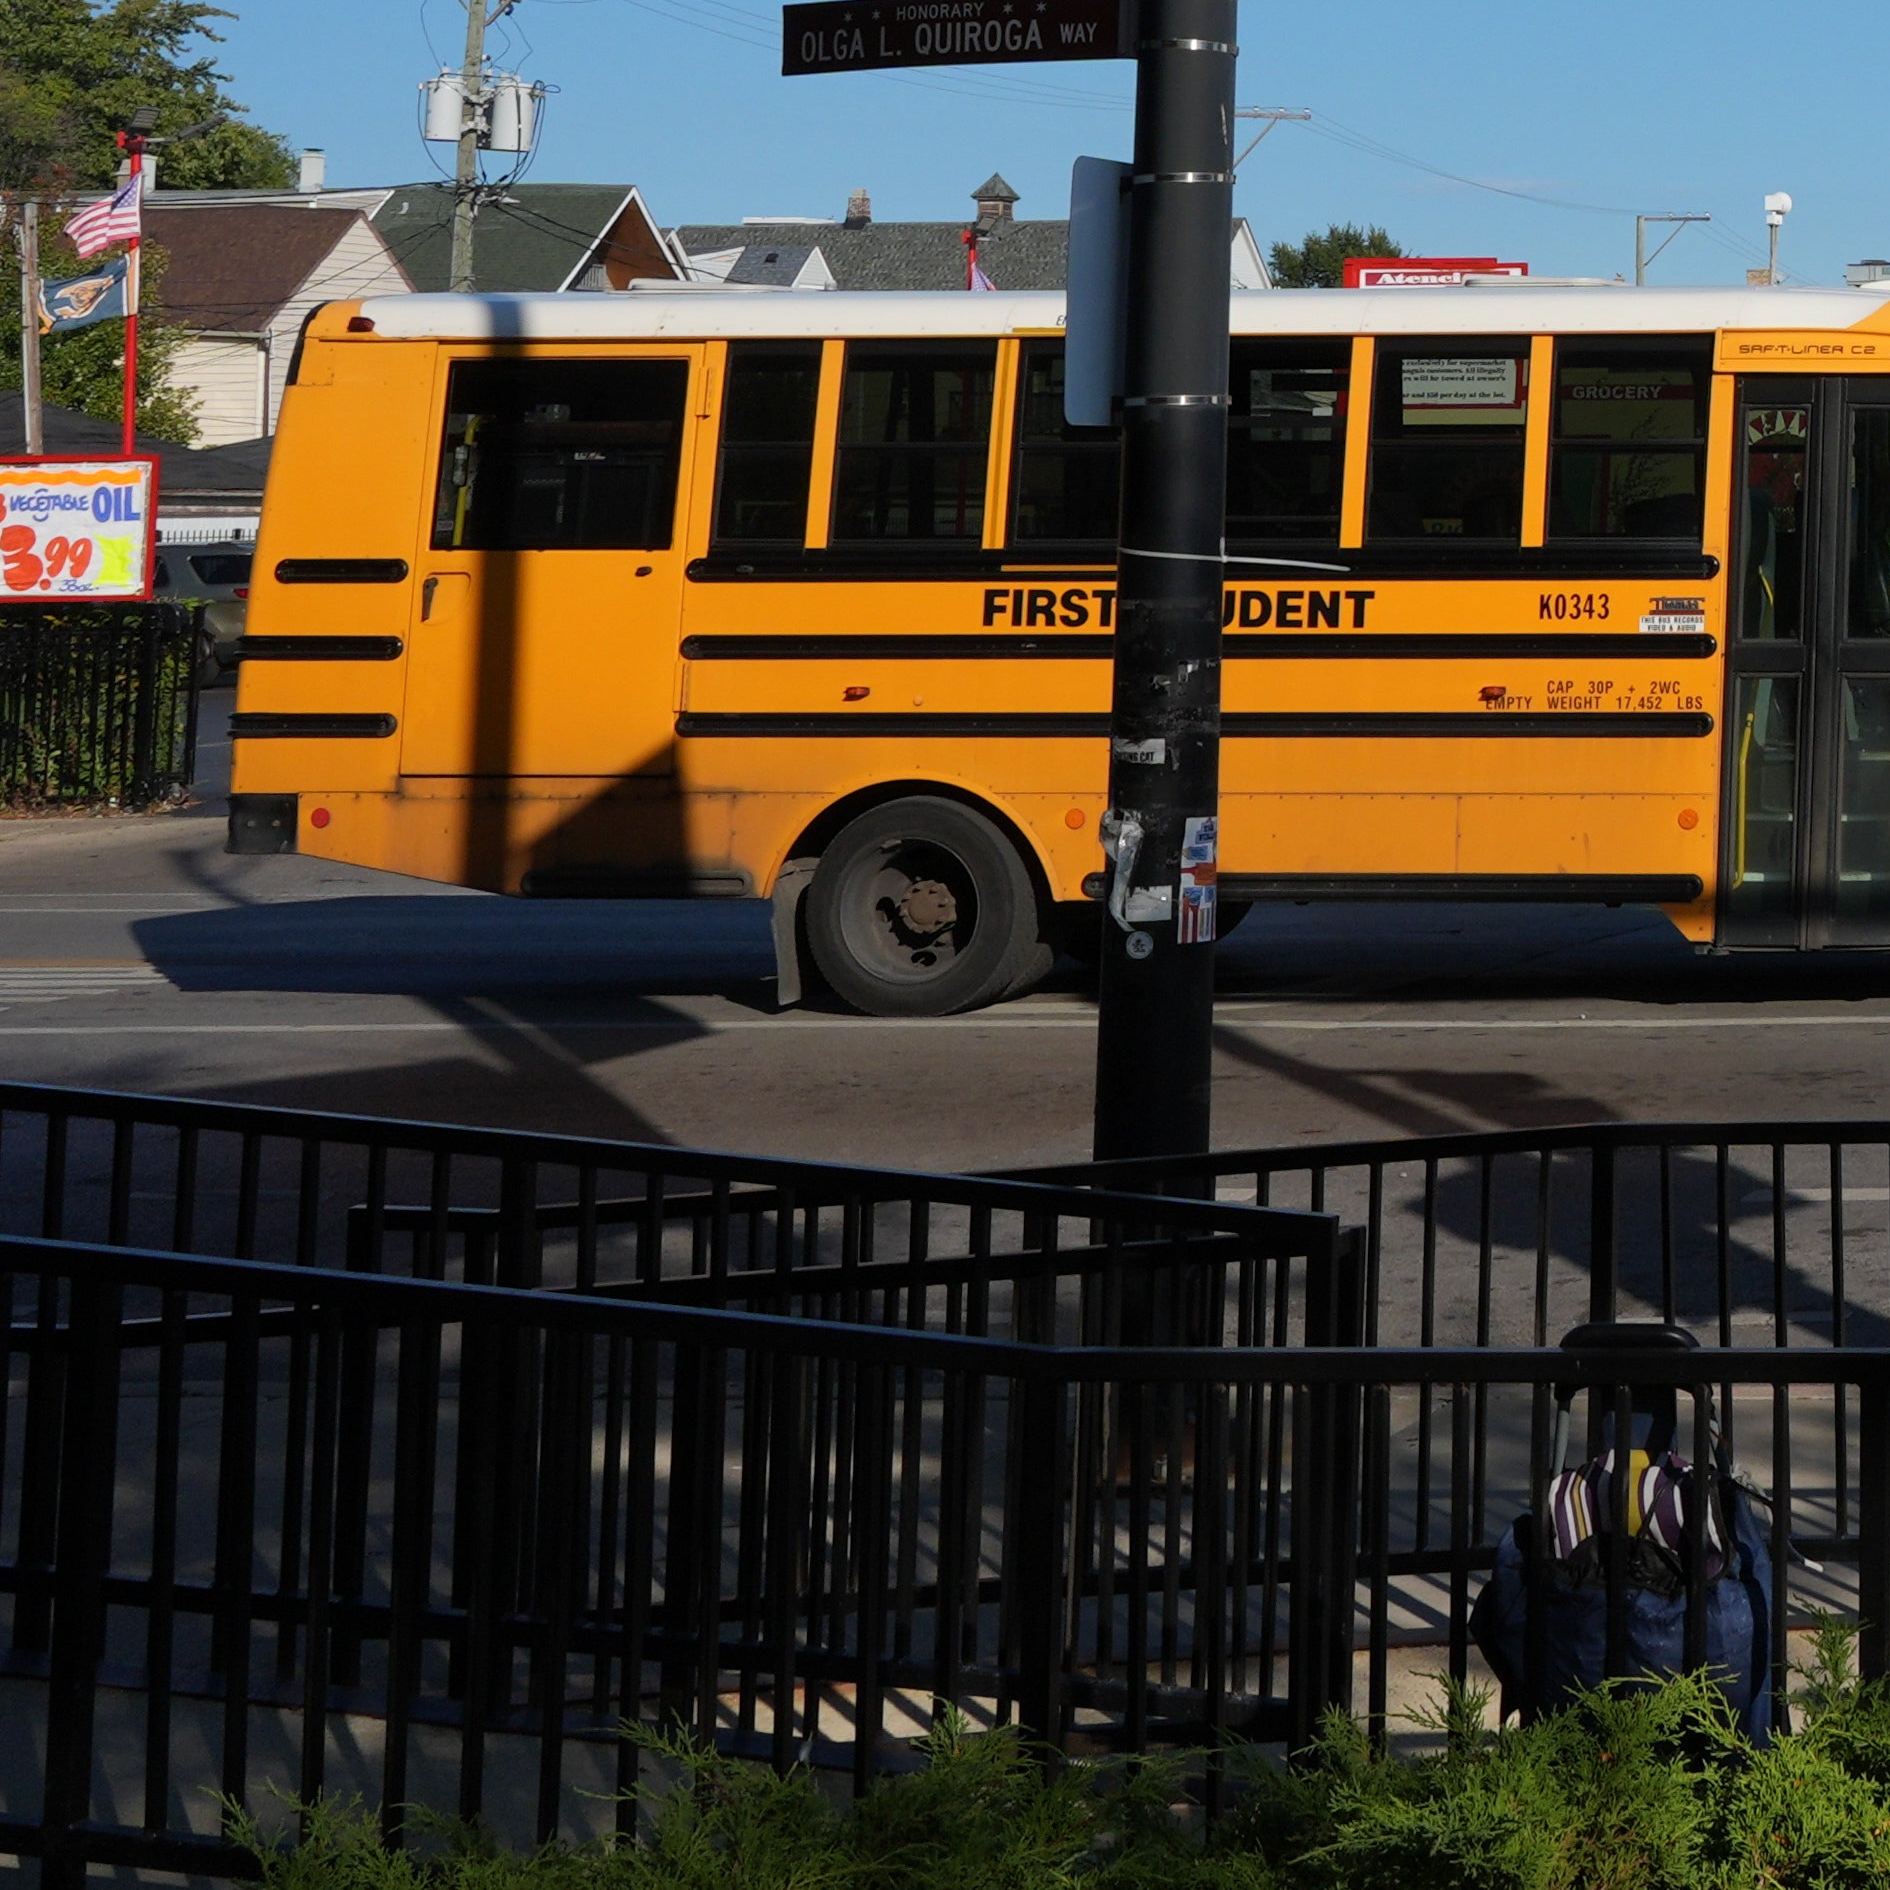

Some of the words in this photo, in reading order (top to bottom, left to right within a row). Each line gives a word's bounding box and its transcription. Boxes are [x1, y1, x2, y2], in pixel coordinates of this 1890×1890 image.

[896, 2, 984, 21] HONORARY
[801, 28, 865, 63] OLGA
[880, 26, 902, 58] L.
[914, 19, 1044, 55] QUIROGA
[1059, 22, 1098, 45] WAY
[1851, 344, 1876, 356] C2
[1571, 385, 1663, 400] GROCERY
[92, 486, 142, 523] OIL
[0, 524, 93, 592] 3.99
[982, 588, 1117, 628] FIRST
[1546, 680, 1574, 694] CAP
[1588, 680, 1614, 694] 30P
[1628, 685, 1636, 694] +
[1649, 680, 1682, 694] 2WC
[1484, 695, 1533, 710] EMPTY
[1546, 695, 1602, 710] WEIGHT
[1616, 695, 1662, 712] 17,452
[1677, 695, 1703, 710] LBS
[1139, 750, 1155, 762] CAT
